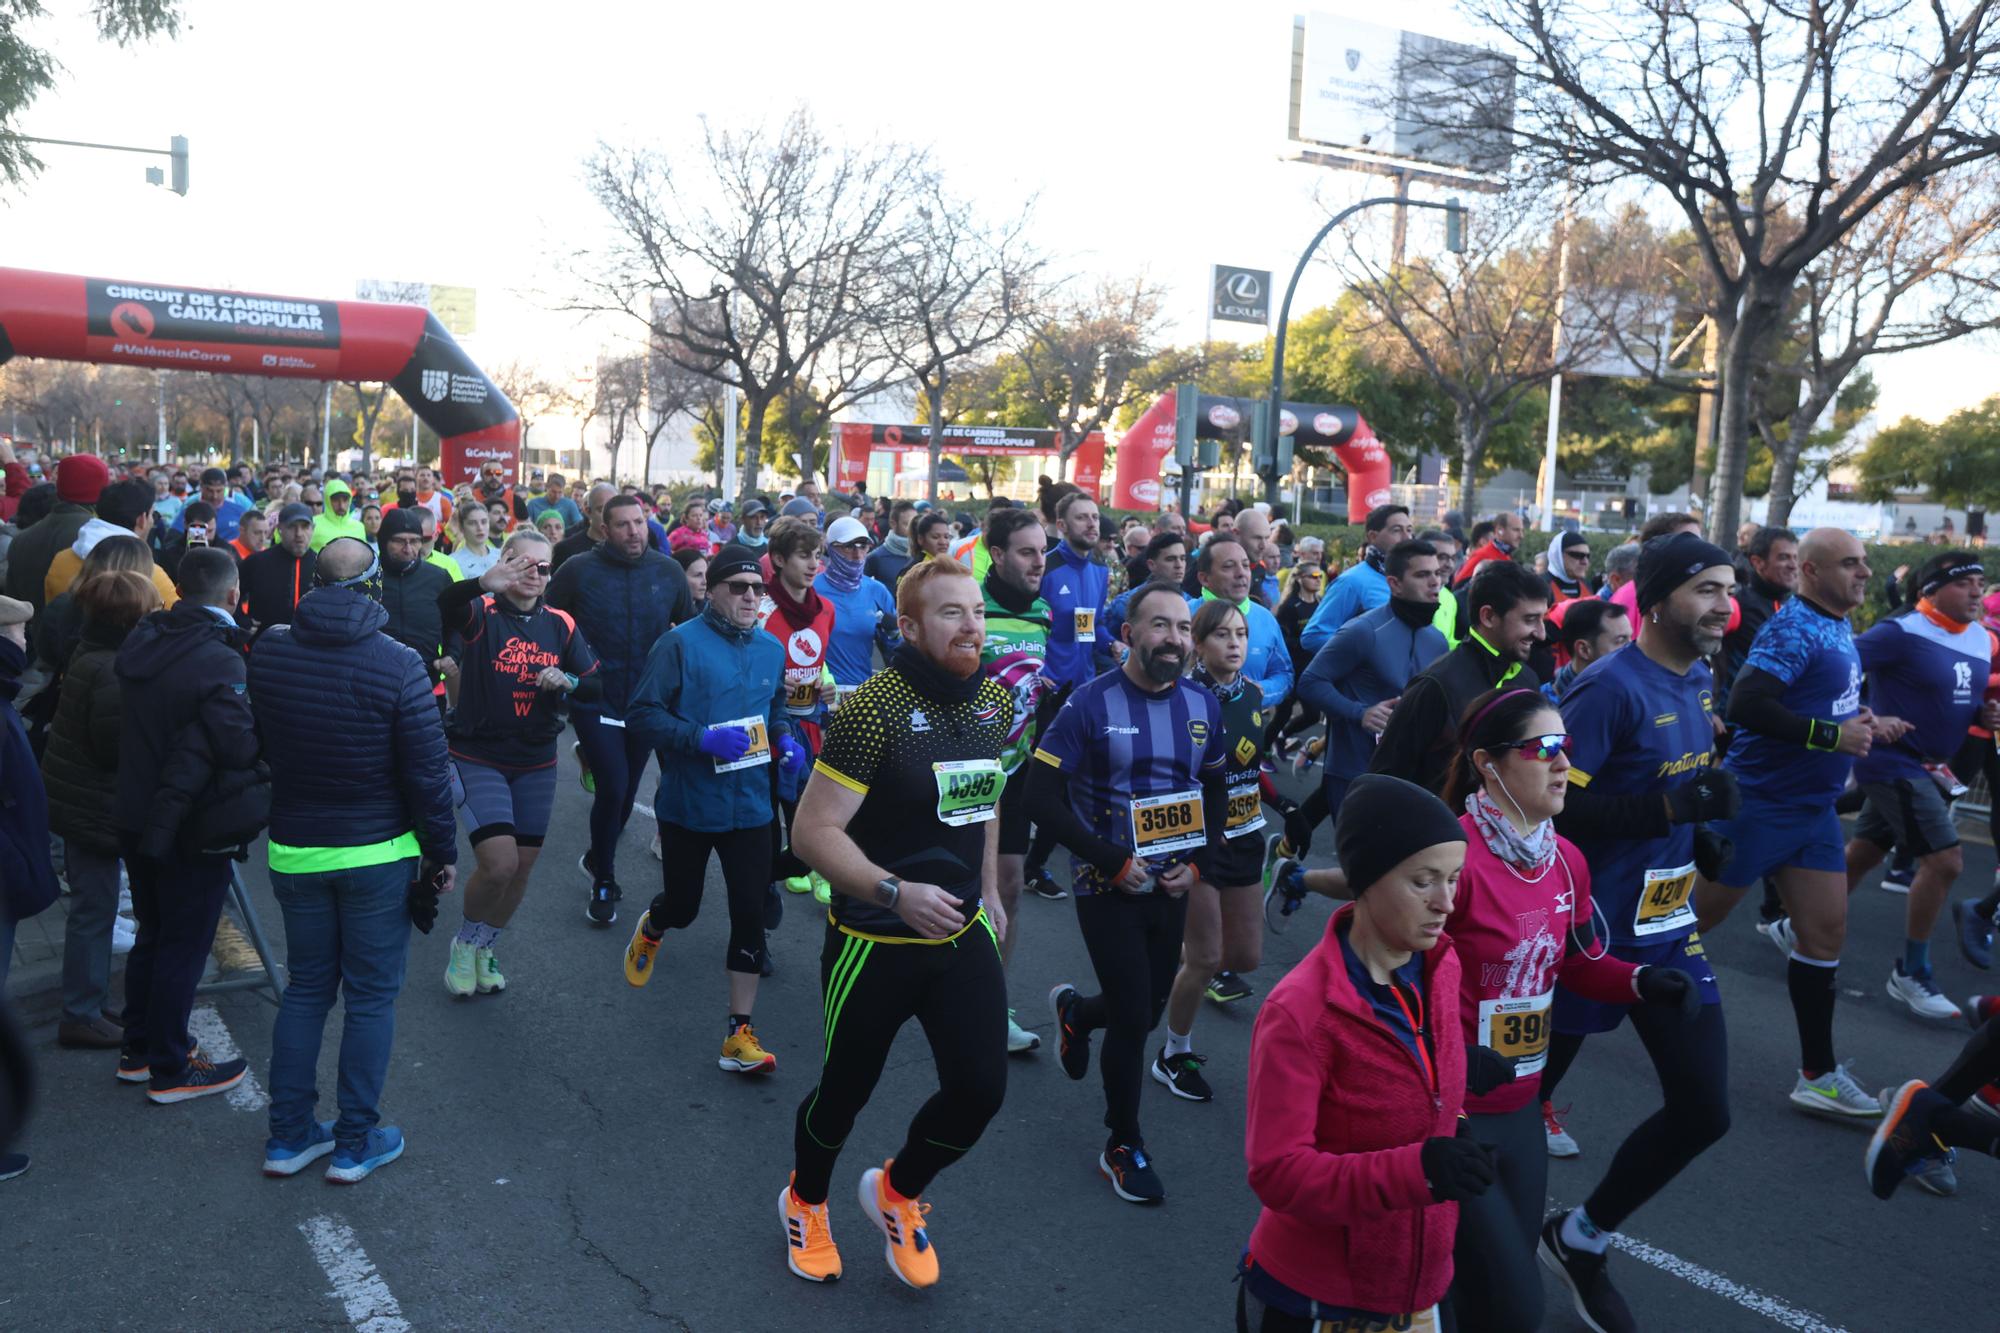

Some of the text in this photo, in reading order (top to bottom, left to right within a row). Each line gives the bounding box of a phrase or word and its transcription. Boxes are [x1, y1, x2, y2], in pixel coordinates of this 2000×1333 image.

[106, 285, 320, 316] CIRCUIT DE CARRERES
[1217, 304, 1266, 319] LEXUS
[948, 773, 996, 799] 4395
[1141, 804, 1192, 832] 3568
